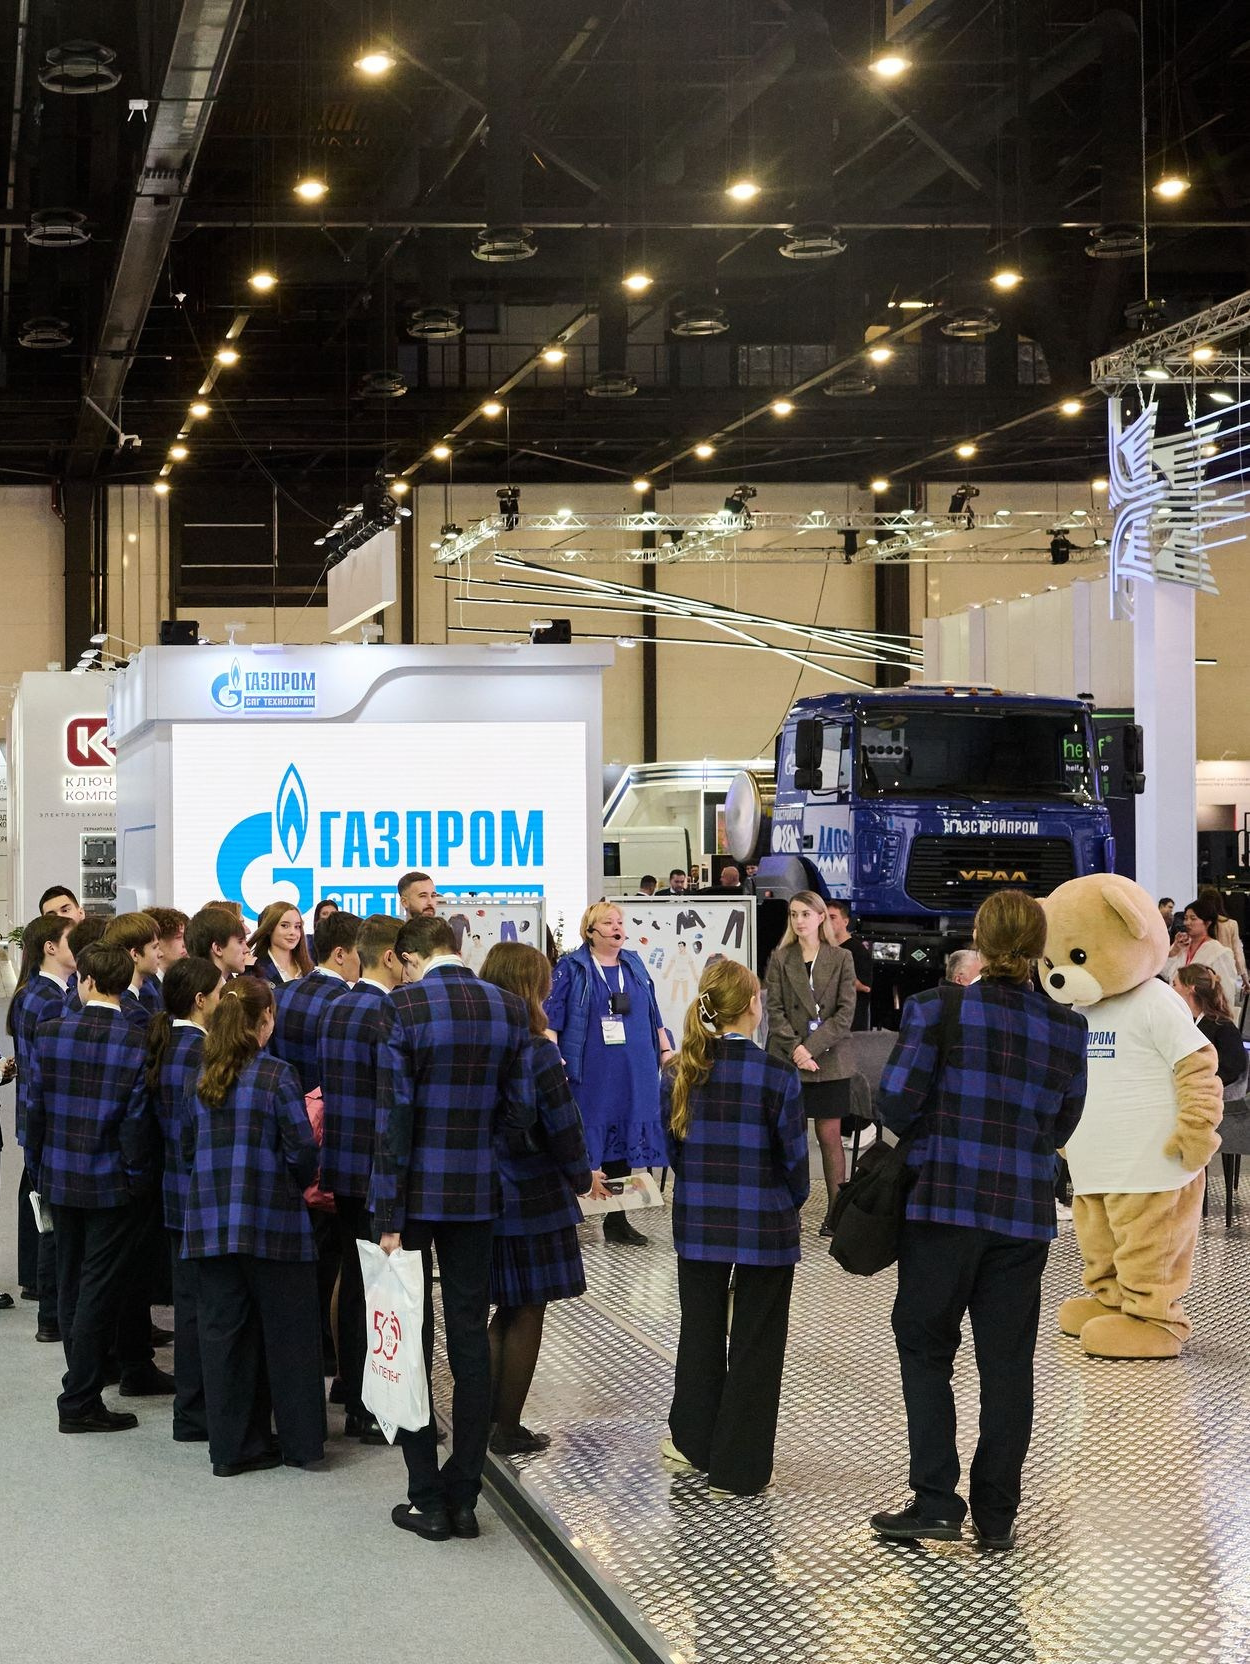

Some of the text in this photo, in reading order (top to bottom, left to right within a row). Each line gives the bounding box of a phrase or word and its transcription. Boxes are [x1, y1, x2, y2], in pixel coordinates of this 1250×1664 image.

[245, 672, 316, 691] ГАЗПРОМ
[245, 697, 314, 706] СПГ ТЕХНОЛОГИИ
[66, 777, 112, 787] КЛЮЧ
[66, 791, 116, 801] КОМПО
[949, 819, 1039, 835] ГАЗСТРОЙПРОМ
[320, 810, 544, 868] ГАЗПРОМ
[958, 870, 1029, 881] УРАЛ
